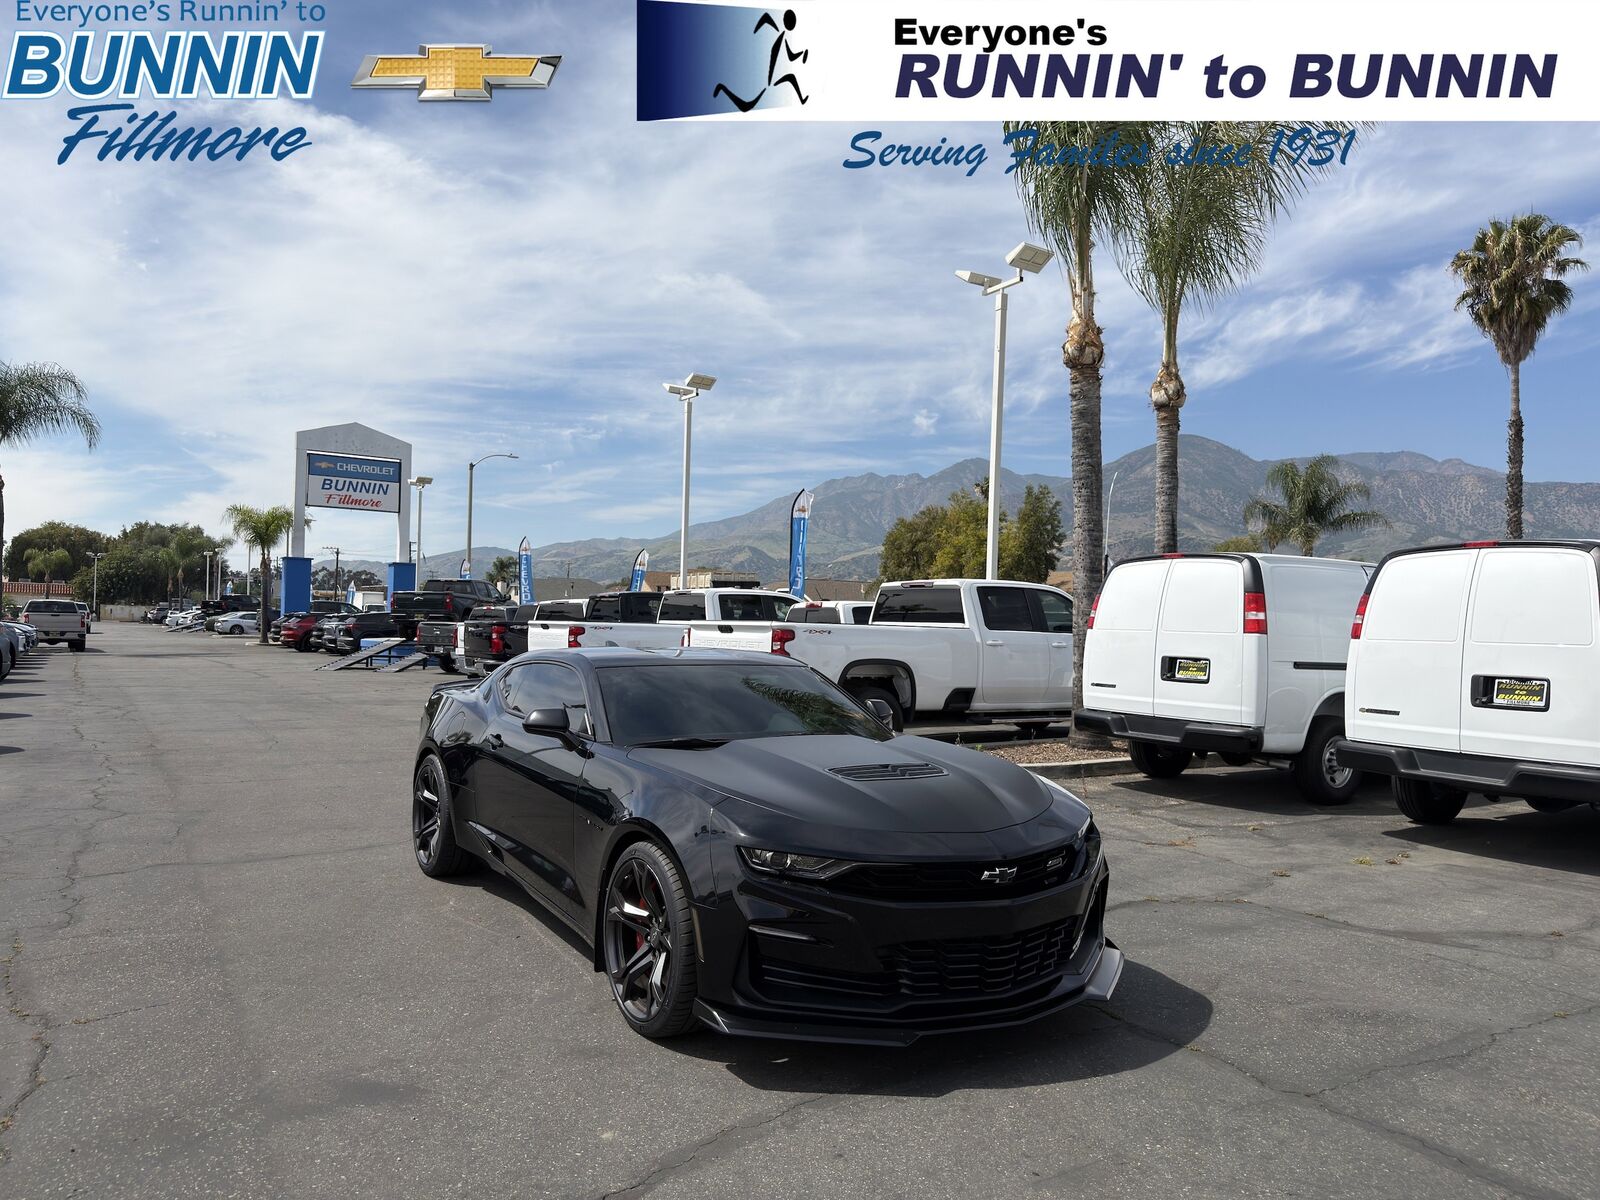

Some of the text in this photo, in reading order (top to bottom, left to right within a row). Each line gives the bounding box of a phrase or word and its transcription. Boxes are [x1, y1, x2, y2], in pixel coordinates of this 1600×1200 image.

[336, 462, 395, 476] CHEVROLET
[320, 478, 390, 496] BUNNIN
[324, 493, 383, 508] Fillmore
